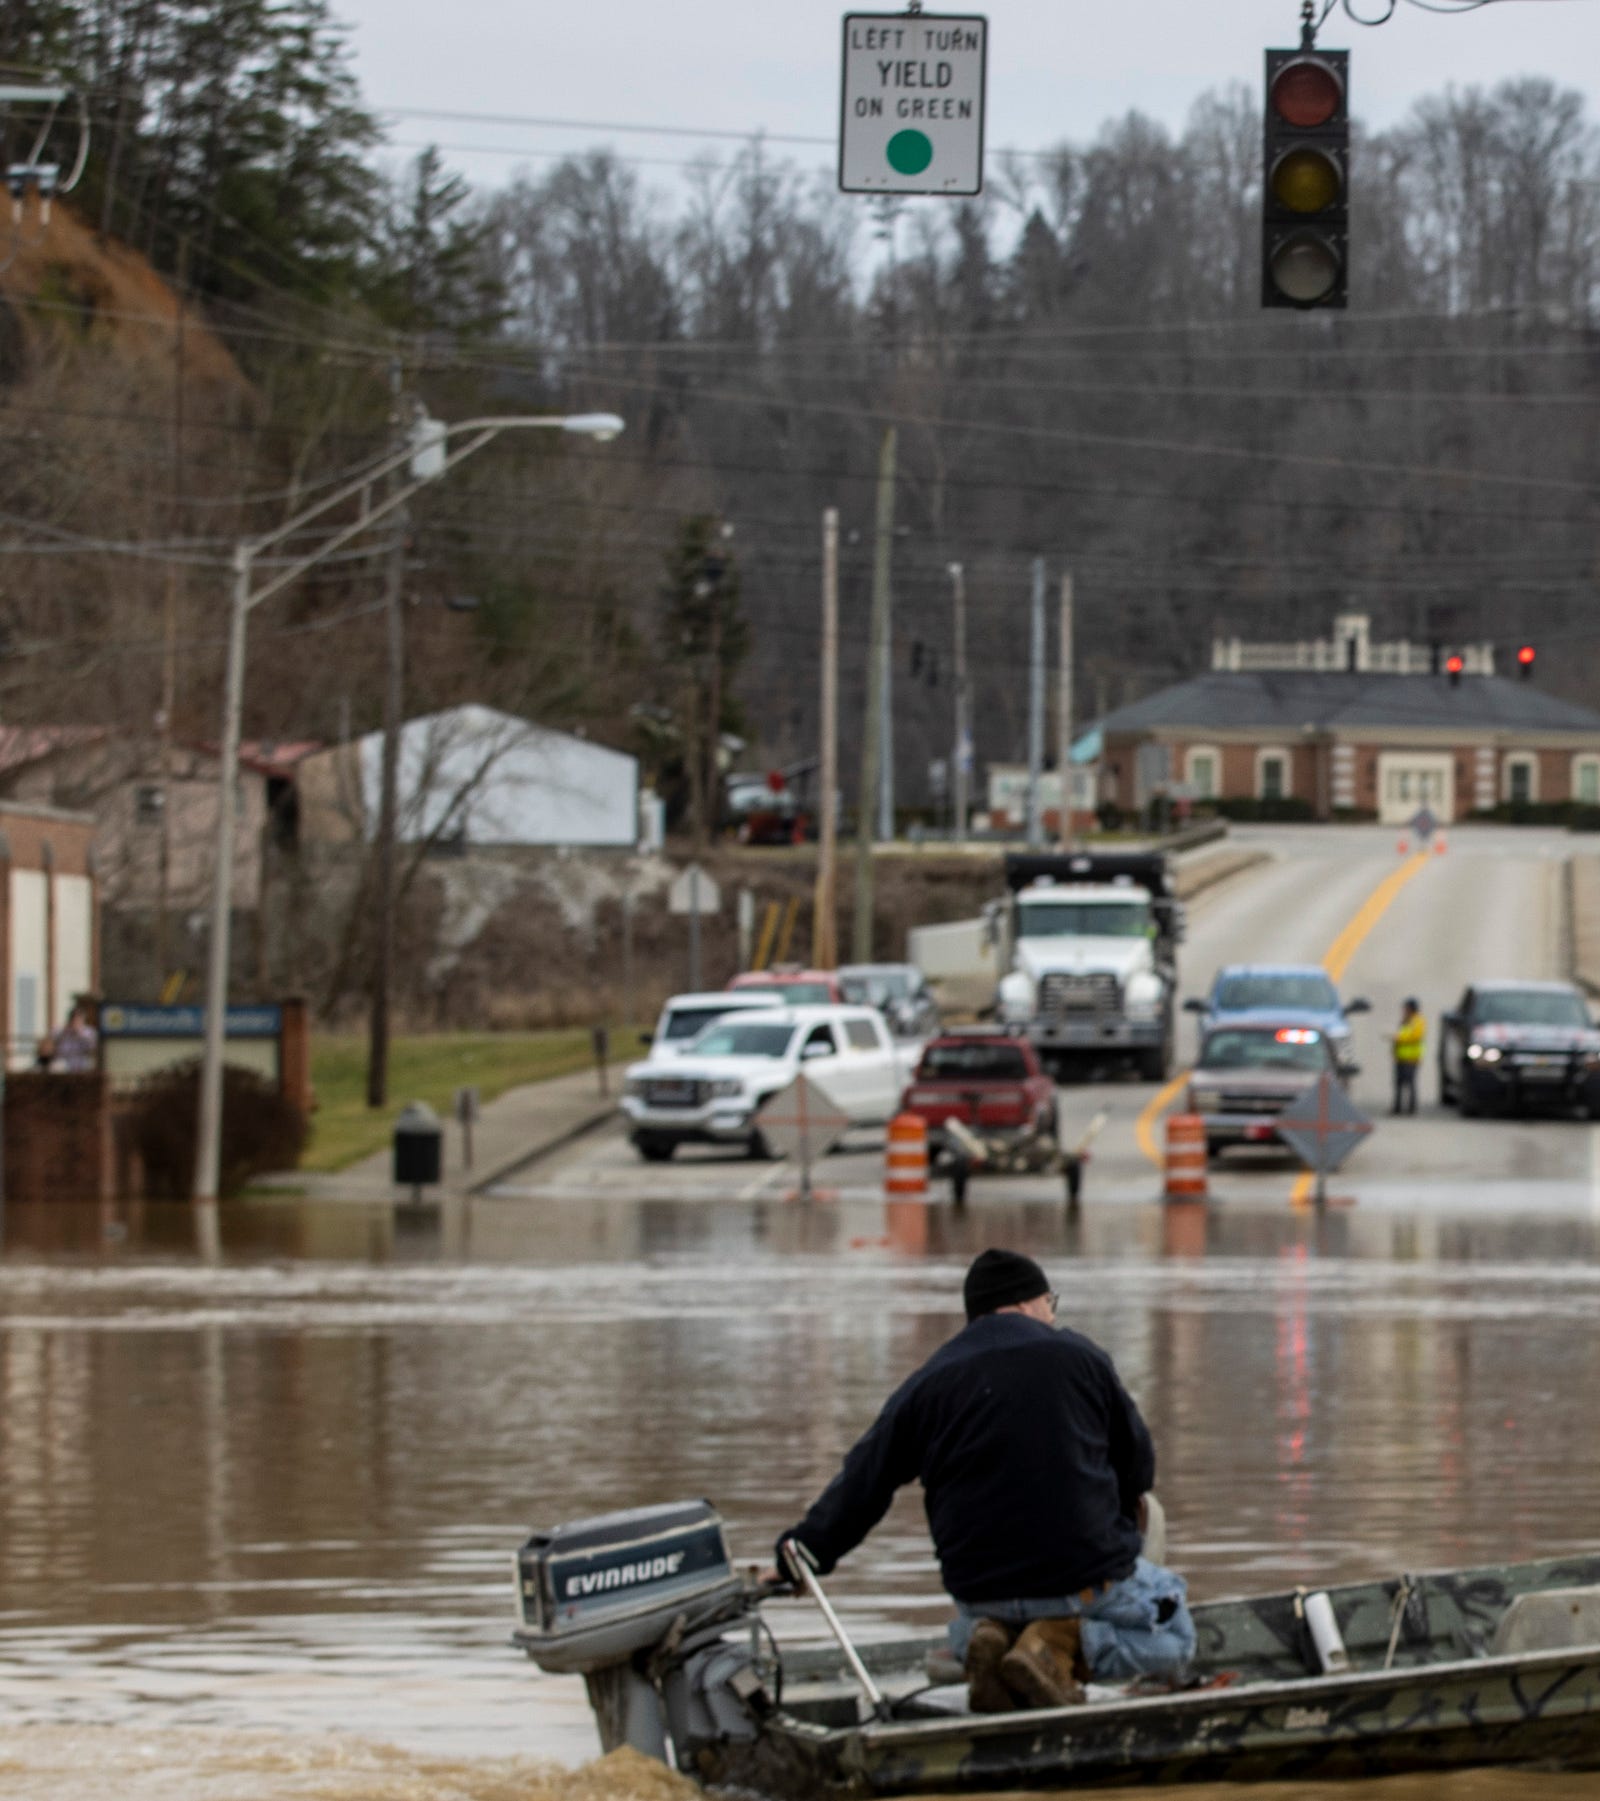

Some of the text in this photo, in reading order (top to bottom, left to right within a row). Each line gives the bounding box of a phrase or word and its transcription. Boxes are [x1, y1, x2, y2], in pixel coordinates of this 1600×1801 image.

[852, 29, 978, 51] LEFT TURN
[877, 60, 953, 88] YIELD
[854, 98, 972, 119] ON GREEN
[565, 1550, 685, 1597] EVINRUDE
